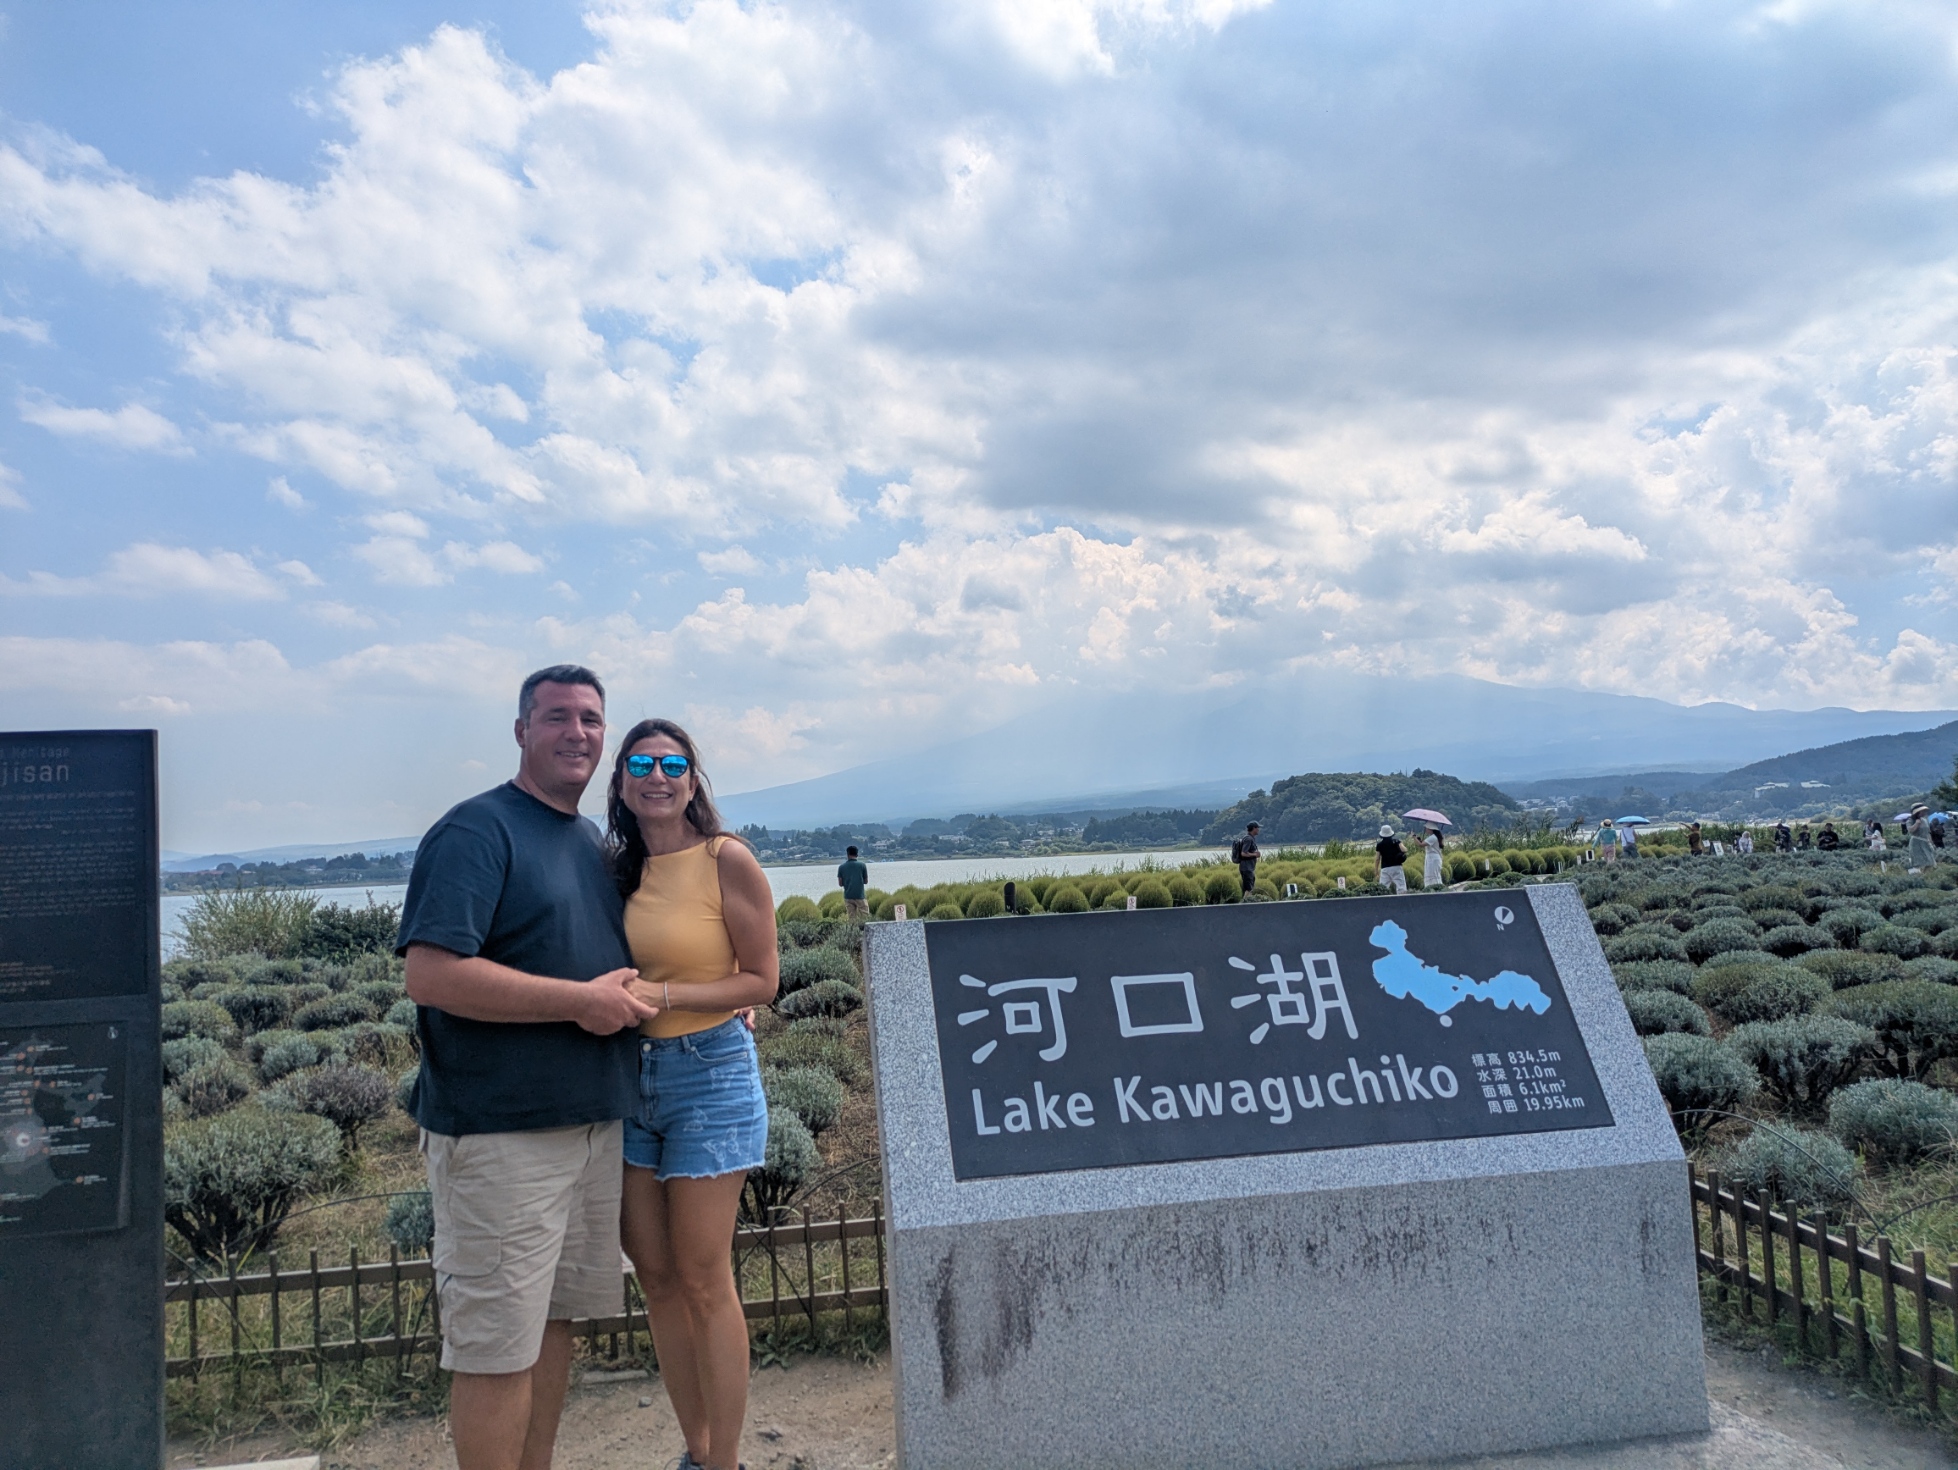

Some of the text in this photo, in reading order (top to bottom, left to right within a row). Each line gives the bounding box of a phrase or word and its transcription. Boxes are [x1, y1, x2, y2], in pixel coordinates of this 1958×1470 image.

[1496, 923, 1505, 931] N
[957, 951, 1359, 1064] 河口湖
[1471, 1049, 1561, 1067] 標高 834.5m
[1476, 1065, 1557, 1083] 水深 21.0m
[971, 1054, 1459, 1136] Lake Kawaguchiko
[1481, 1083, 1513, 1098] 面積
[1487, 1095, 1585, 1114] 周囲 19.95km
